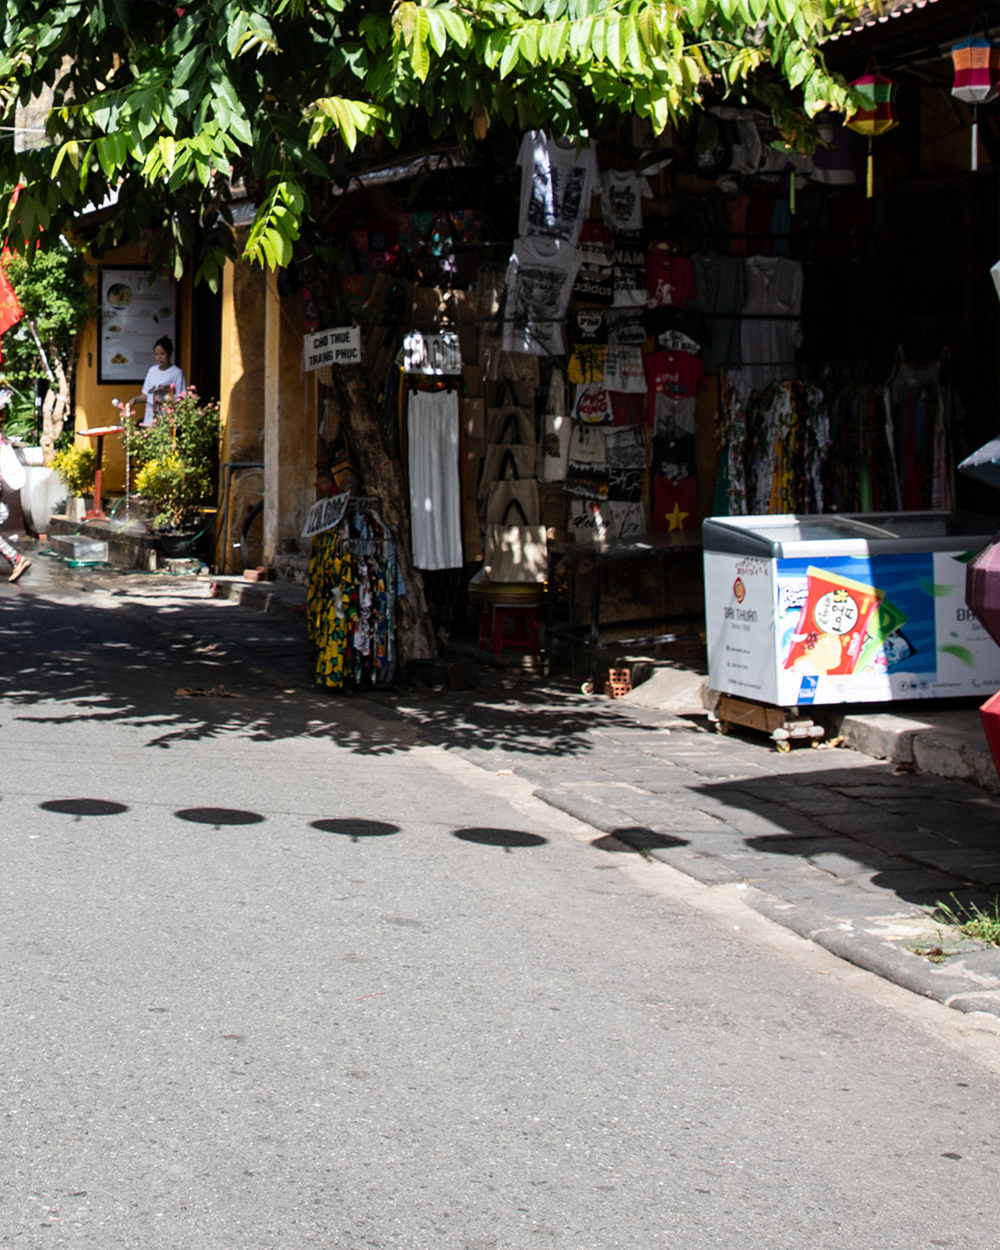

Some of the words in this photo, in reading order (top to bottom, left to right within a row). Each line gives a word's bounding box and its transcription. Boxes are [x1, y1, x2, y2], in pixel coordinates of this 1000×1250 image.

[614, 249, 645, 264] NAM
[573, 281, 613, 296] adidas
[313, 336, 328, 349] CHO
[308, 350, 333, 366] TRANG
[578, 402, 607, 415] KING
